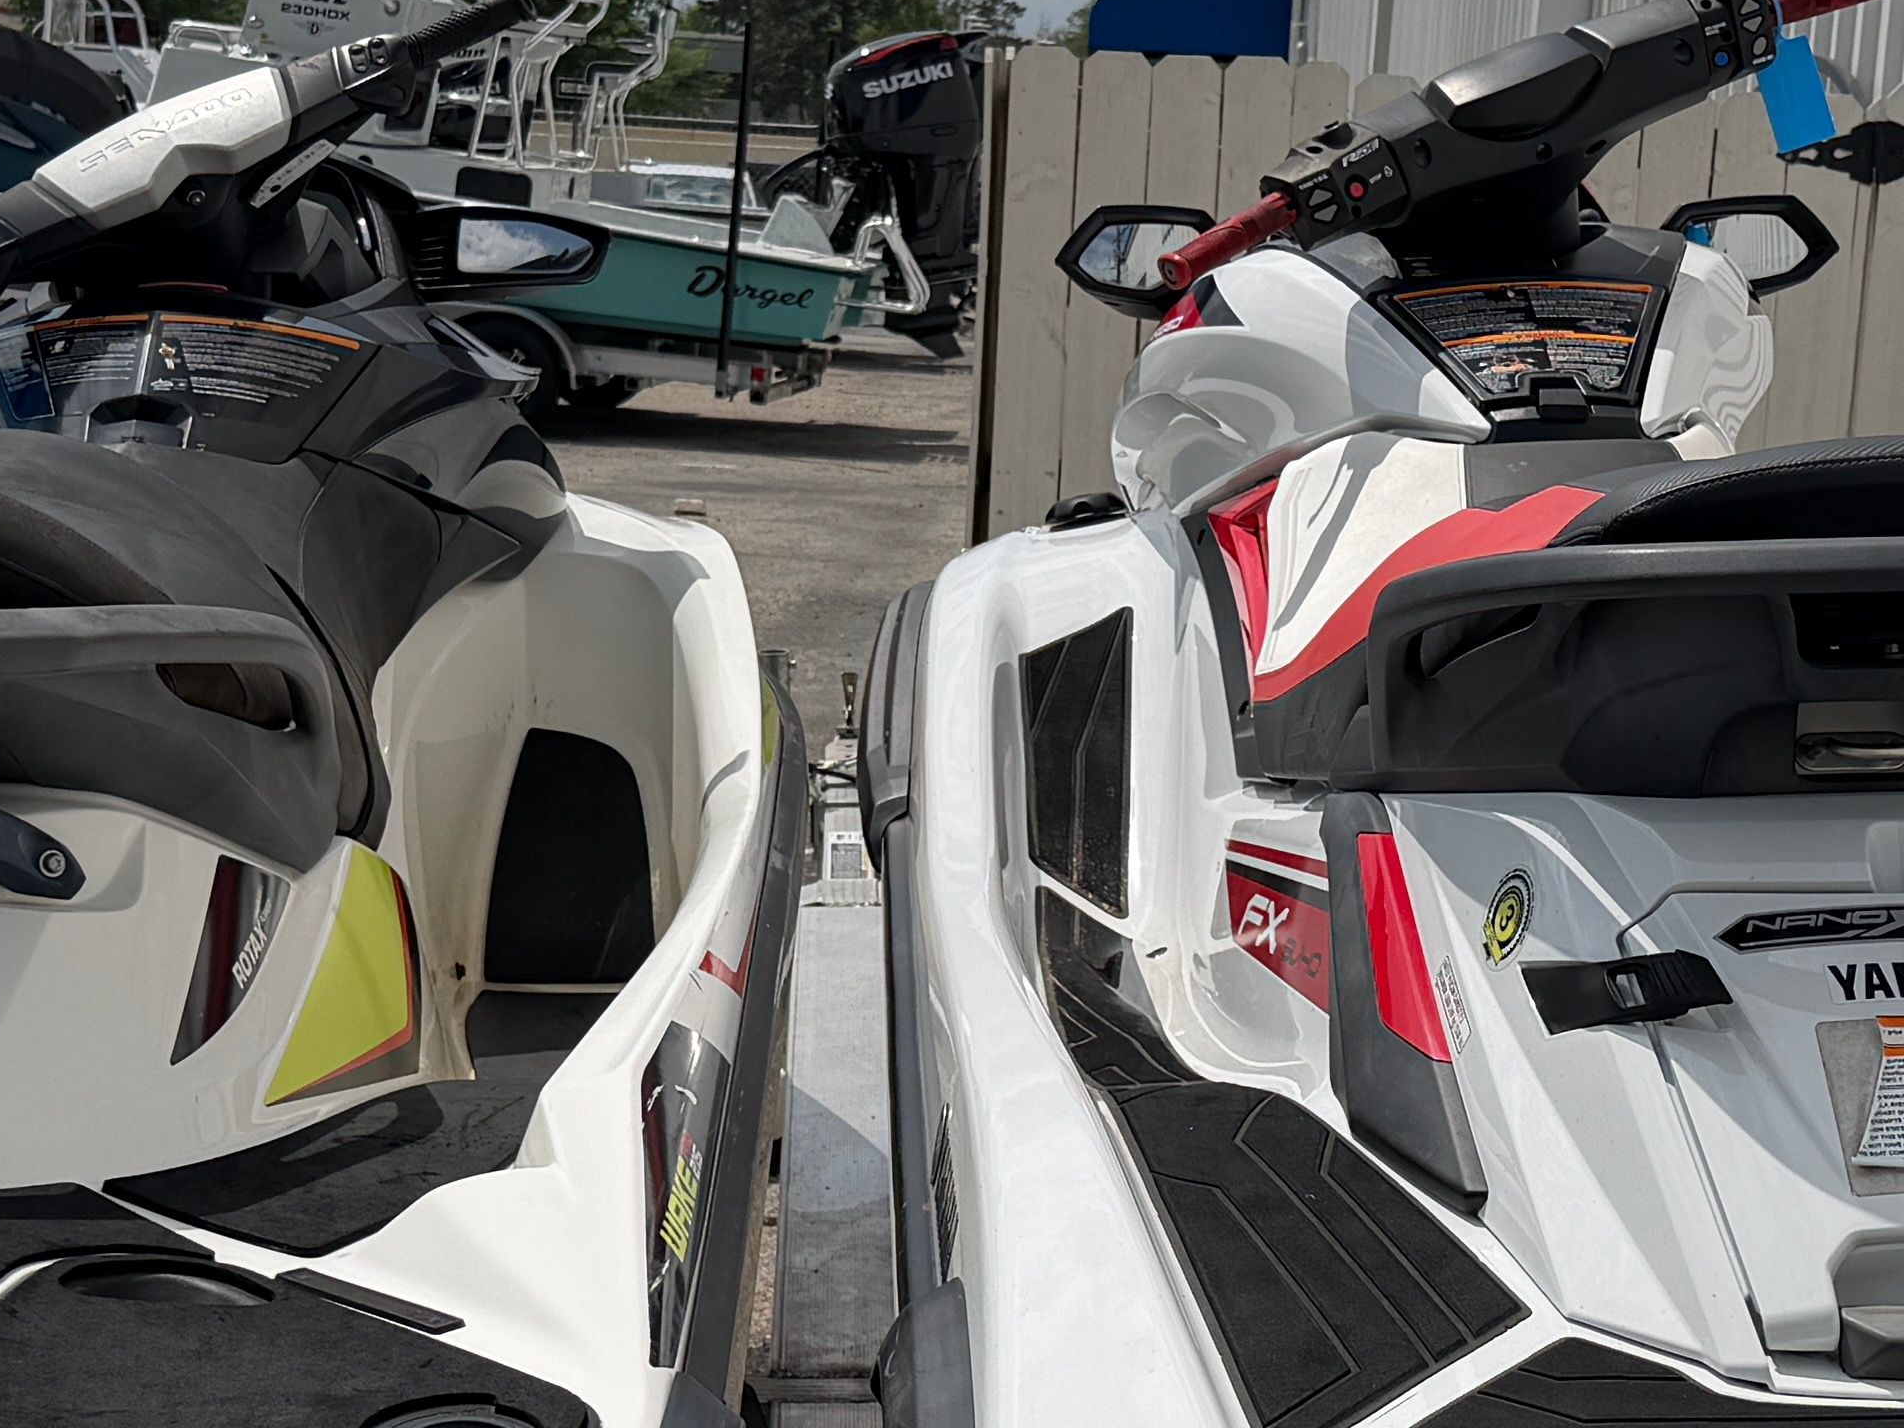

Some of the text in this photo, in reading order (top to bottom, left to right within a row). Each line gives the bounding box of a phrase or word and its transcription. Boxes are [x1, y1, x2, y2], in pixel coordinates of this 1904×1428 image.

[281, 2, 351, 22] 230HDX
[862, 61, 955, 99] SUZUKI
[687, 265, 815, 309] Drgel
[1237, 892, 1290, 955] FX
[232, 918, 268, 990] ROTAX
[659, 1154, 700, 1263] WAKE
